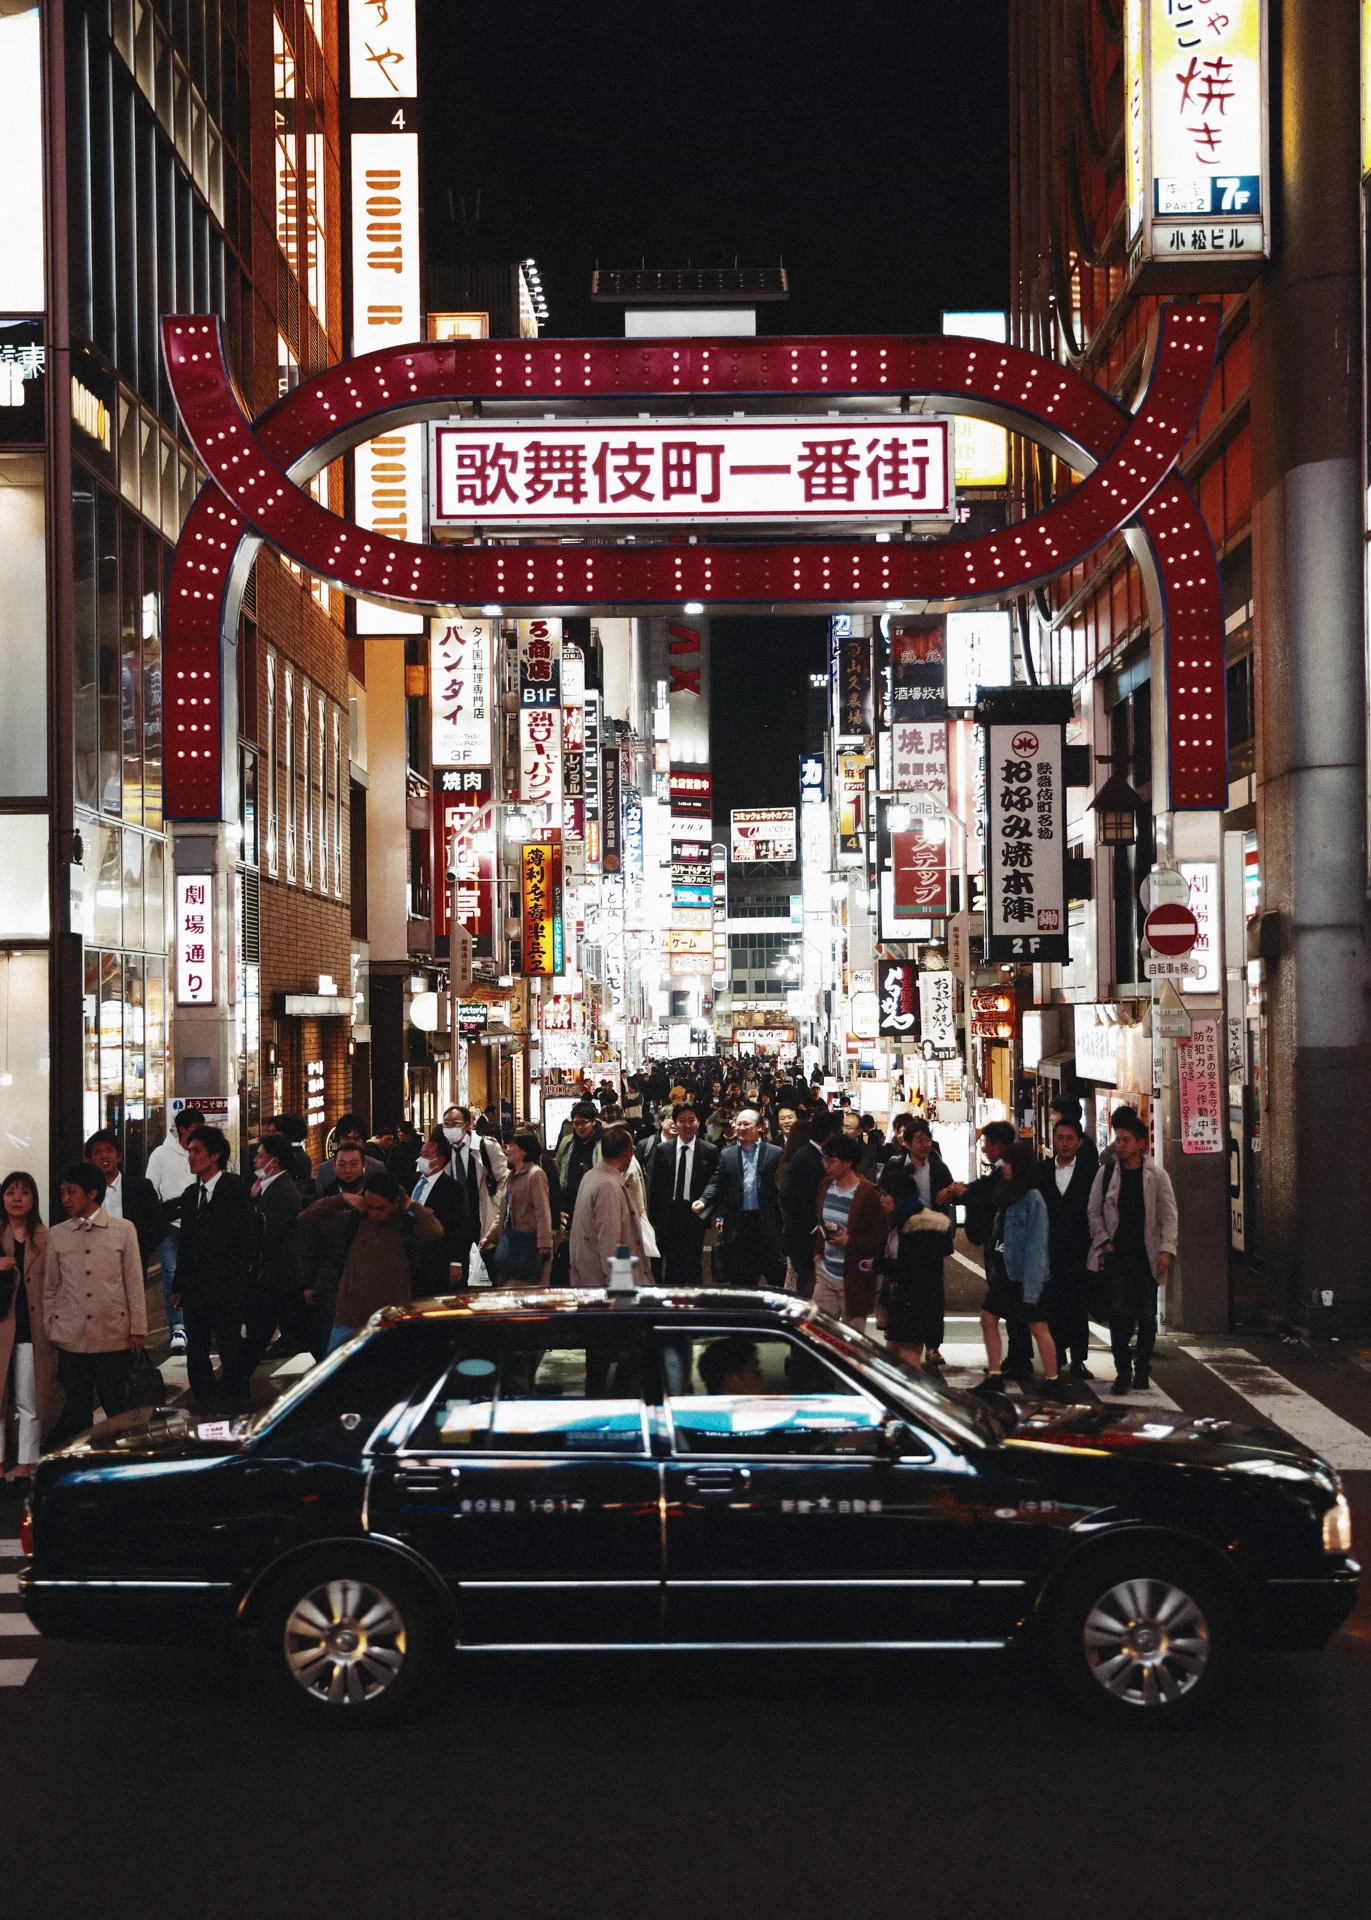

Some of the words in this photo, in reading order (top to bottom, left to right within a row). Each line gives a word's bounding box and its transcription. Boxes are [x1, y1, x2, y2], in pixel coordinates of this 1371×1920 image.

[391, 109, 406, 130] 4
[1216, 178, 1251, 210] 7F
[1170, 229, 1244, 250] 小松ビル
[455, 437, 930, 506] 歌舞伎町一番街
[439, 626, 467, 726] バンタイ
[523, 688, 557, 702] B1F
[451, 750, 472, 760] 3F
[442, 771, 482, 791] 焼肉
[1036, 762, 1053, 839] 歌舞伎町名物
[1000, 759, 1035, 923] お好み焼本陣
[185, 885, 205, 991] 劇場通り
[1012, 938, 1040, 954] 2F
[1148, 963, 1196, 975] 自転車を除く
[1194, 1032, 1208, 1131] 防犯カメラ作動中
